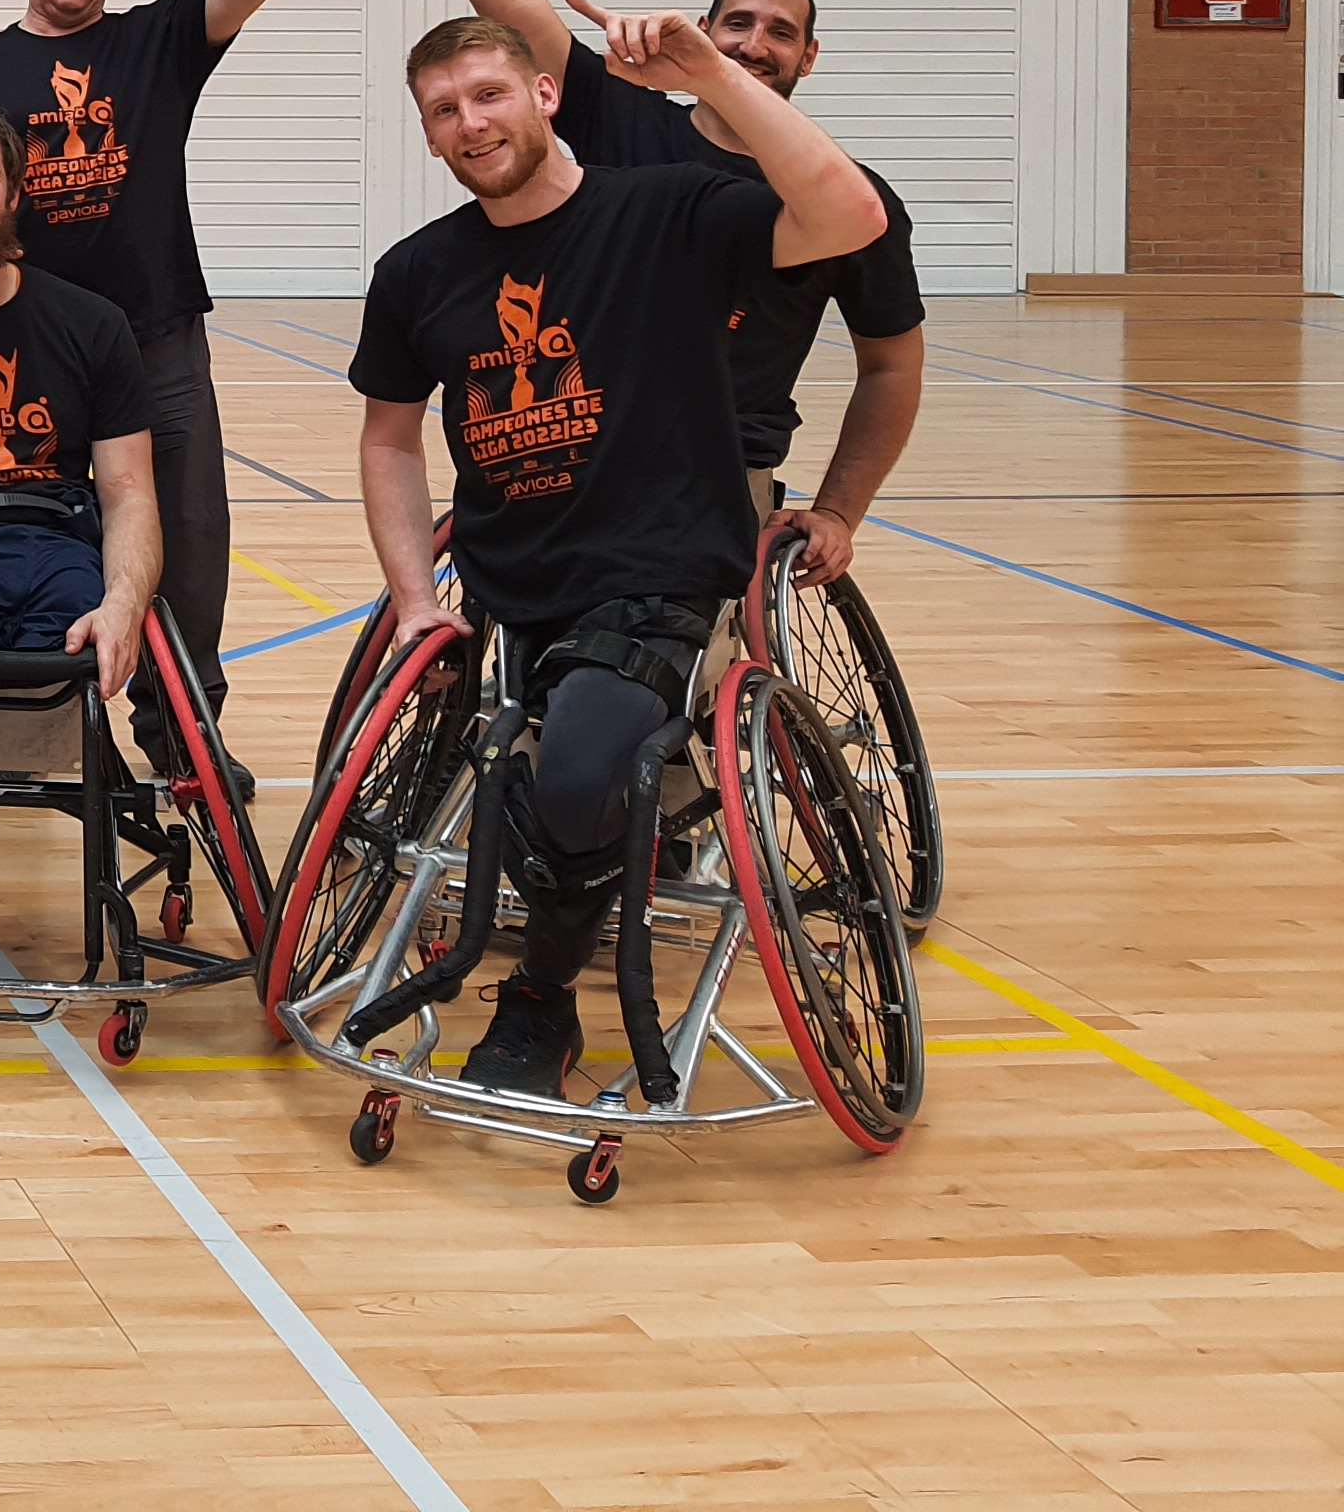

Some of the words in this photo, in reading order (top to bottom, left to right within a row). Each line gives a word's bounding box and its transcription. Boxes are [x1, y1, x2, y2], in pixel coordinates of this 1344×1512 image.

[29, 106, 86, 125] amiab
[26, 153, 106, 178] AMPEONES
[108, 148, 129, 164] DE
[24, 178, 62, 193] LIGA
[47, 202, 109, 224] gaviota
[464, 400, 568, 444] CAMPEONES
[573, 396, 603, 415] DE
[471, 442, 509, 462] LIGA
